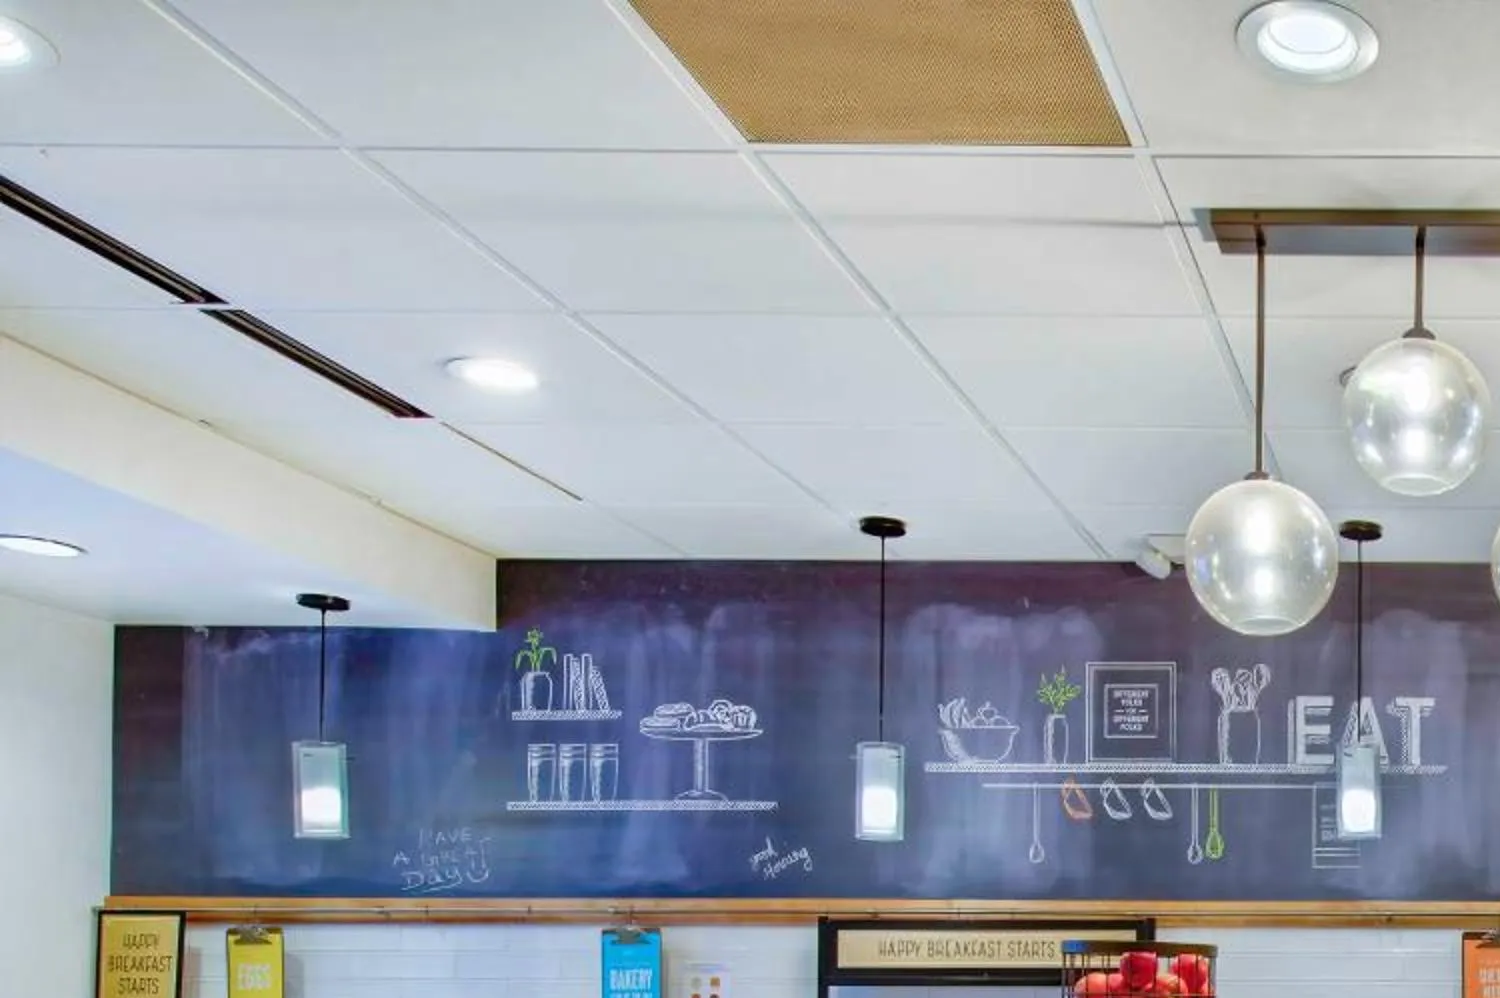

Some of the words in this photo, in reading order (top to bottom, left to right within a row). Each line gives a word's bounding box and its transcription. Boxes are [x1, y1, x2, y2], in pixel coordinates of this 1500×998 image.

[1287, 695, 1436, 767] EAT
[122, 931, 160, 949] HAPPY
[878, 938, 922, 957] HAPPY
[926, 938, 1002, 958] BREAKFAST
[1007, 938, 1056, 958] STARTS
[107, 955, 173, 973] BREAKFAST
[117, 977, 161, 996] STARTS
[609, 968, 653, 990] BAKERY
